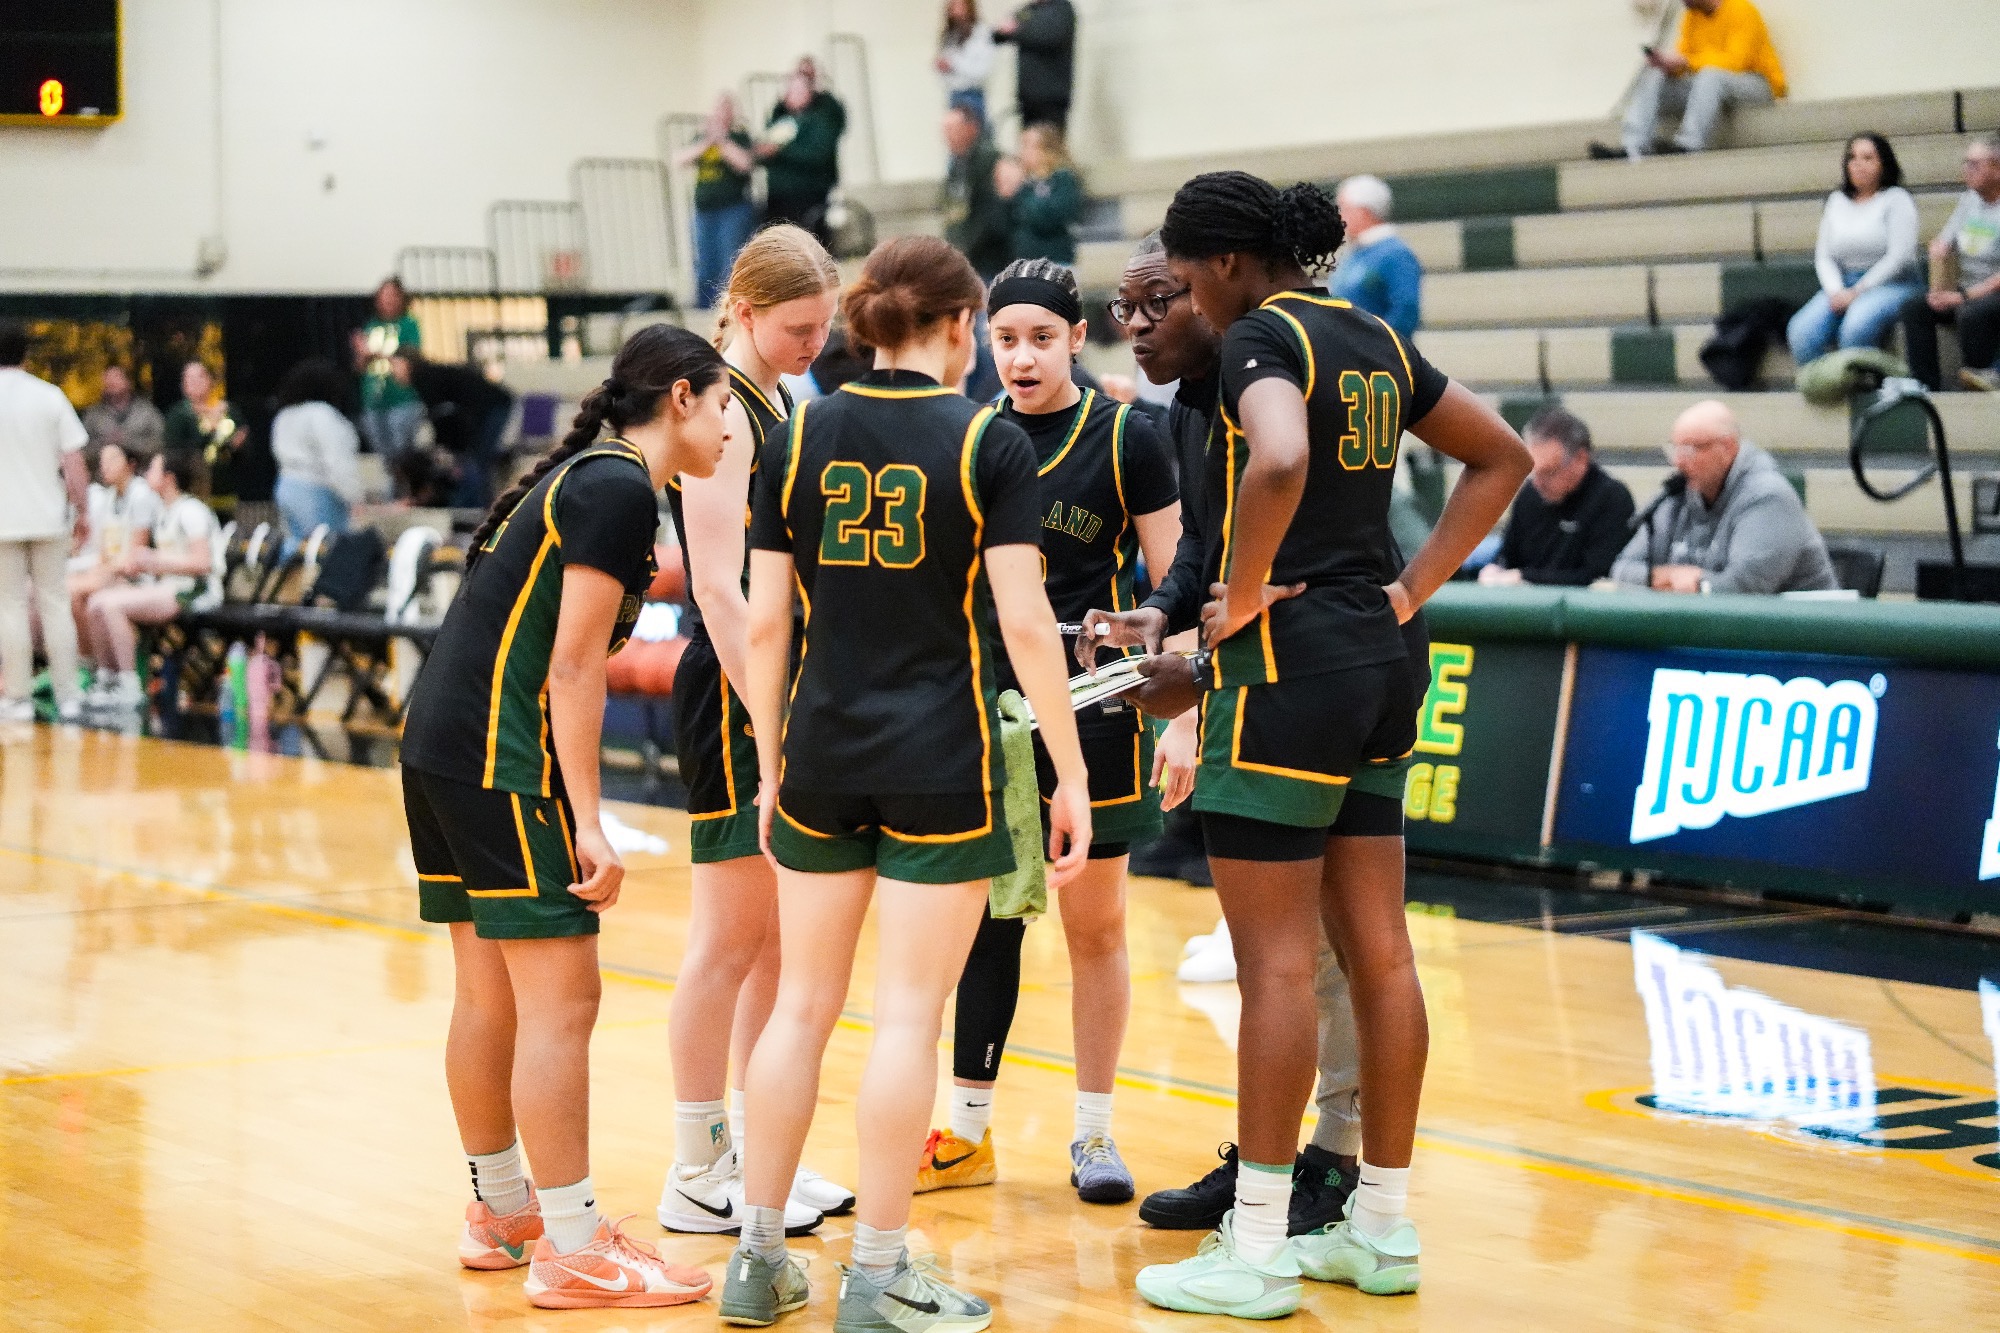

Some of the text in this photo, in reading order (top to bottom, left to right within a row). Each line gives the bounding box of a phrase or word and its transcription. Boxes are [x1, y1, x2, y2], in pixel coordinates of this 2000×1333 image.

[1338, 370, 1400, 470] 30
[818, 460, 927, 569] 23
[1040, 500, 1103, 544] AND
[1649, 692, 1862, 816] NJCAA
